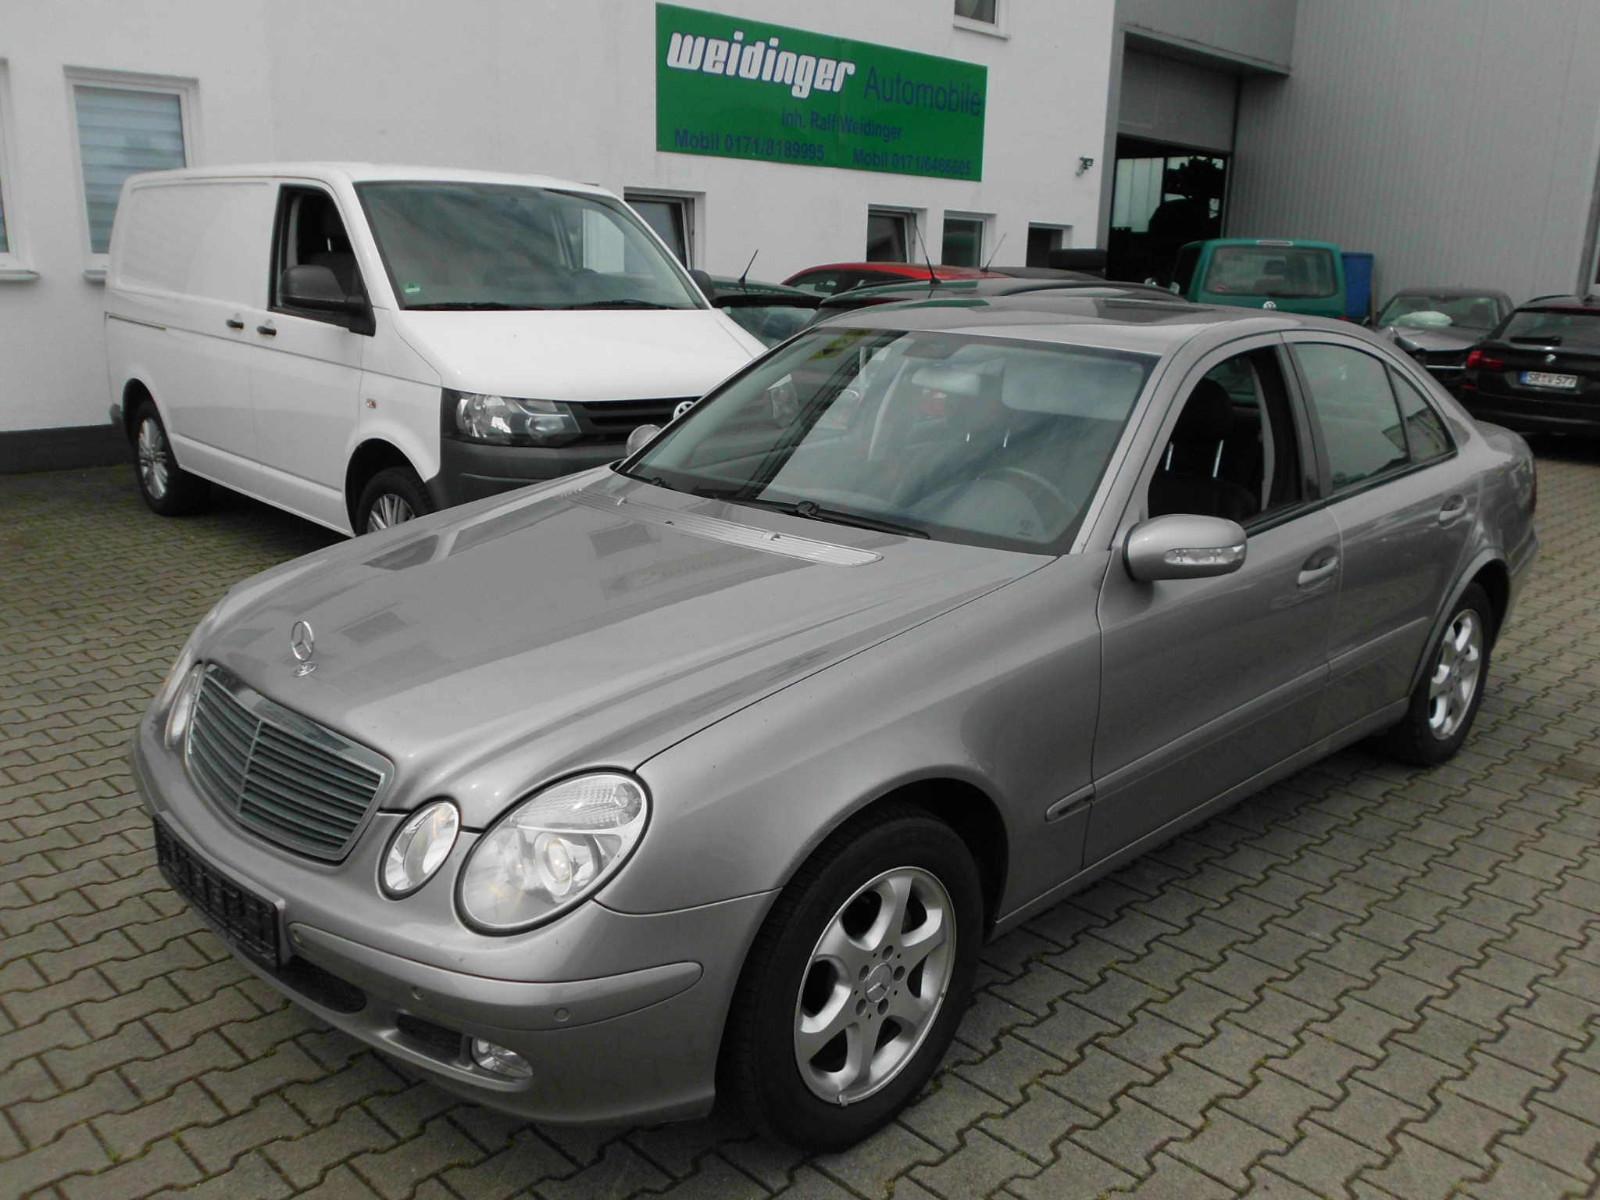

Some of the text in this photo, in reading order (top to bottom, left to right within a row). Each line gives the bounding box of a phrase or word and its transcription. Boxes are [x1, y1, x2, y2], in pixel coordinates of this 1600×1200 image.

[666, 30, 982, 117] weidinger Automobile
[674, 128, 720, 151] Mobil
[810, 110, 838, 133] Ralf
[839, 114, 904, 142] Weidinger
[852, 147, 888, 169] Mobil
